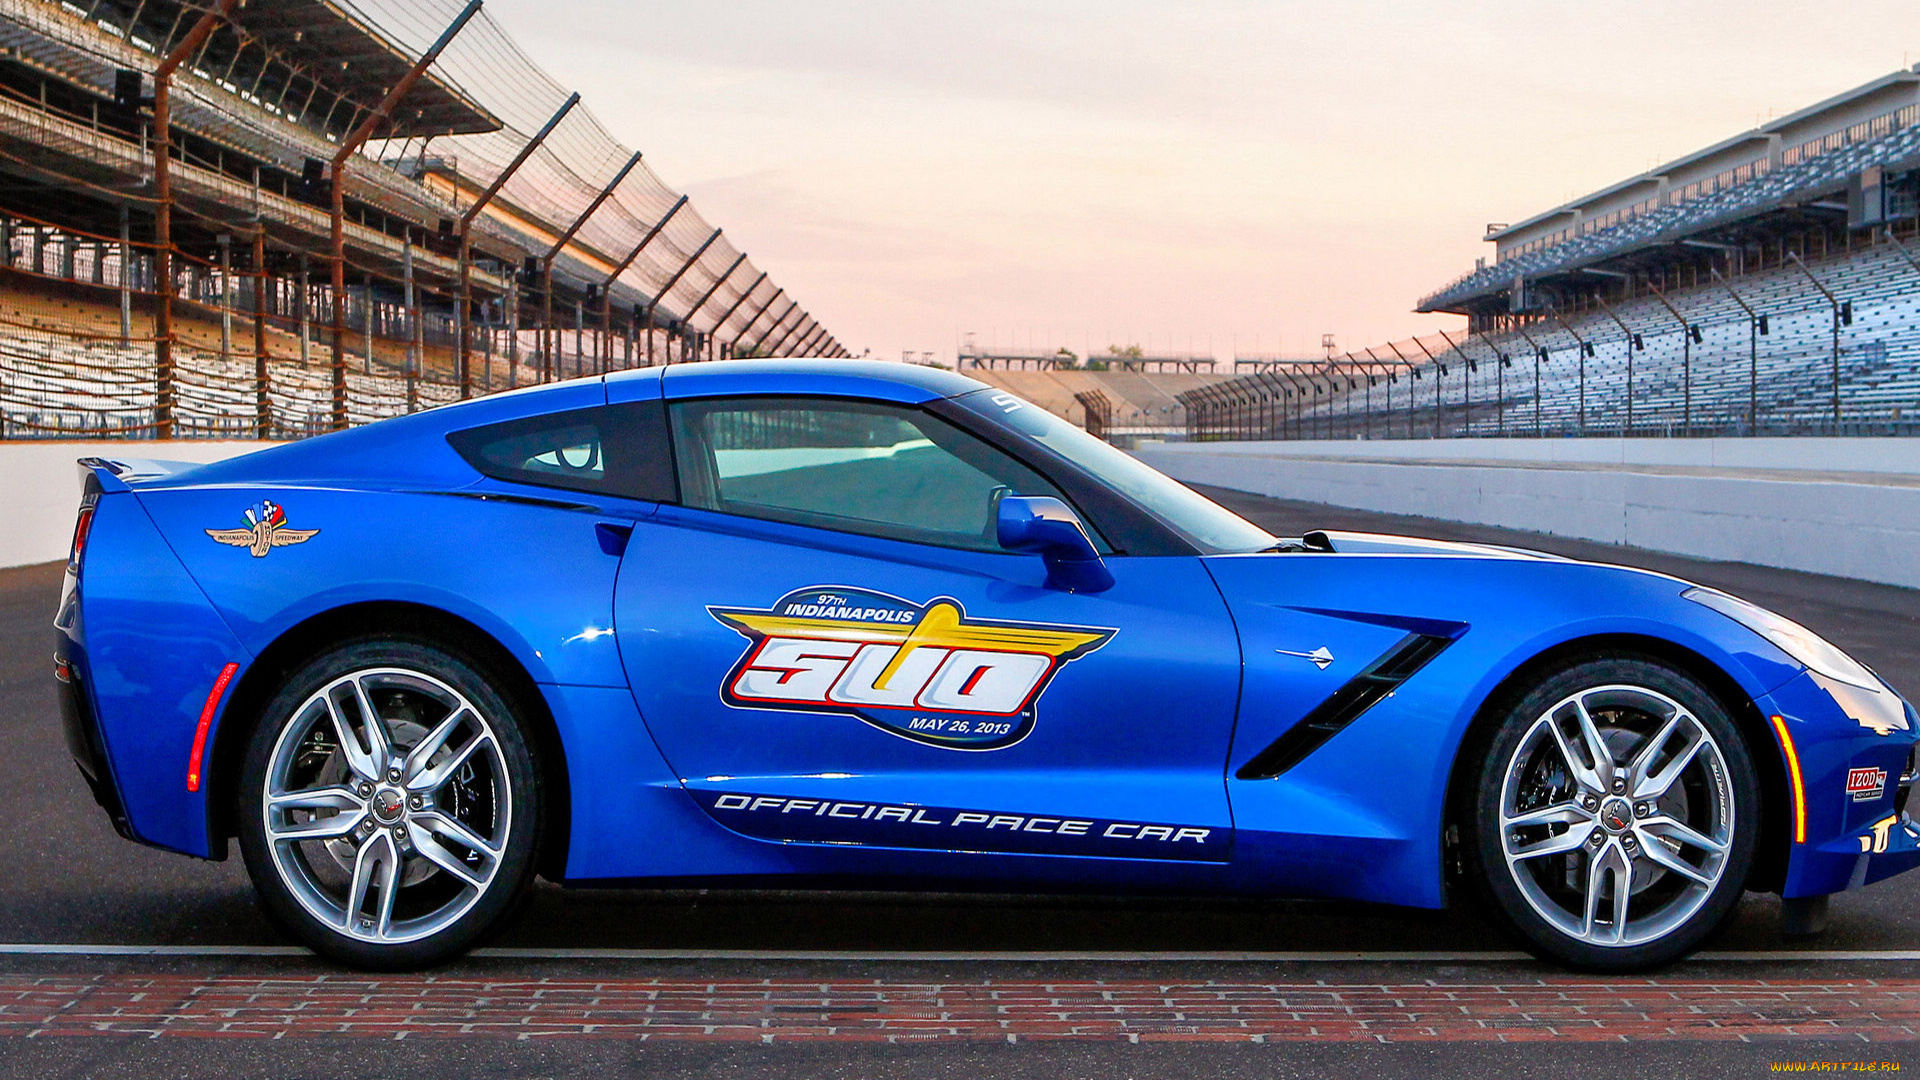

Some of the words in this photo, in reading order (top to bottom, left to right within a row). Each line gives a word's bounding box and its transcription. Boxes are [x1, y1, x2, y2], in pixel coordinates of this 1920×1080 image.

[816, 594, 848, 606] 97TH
[783, 603, 916, 623] INDIANAPOLIS
[733, 637, 1051, 714] 500
[908, 717, 949, 729] MAY
[948, 721, 971, 733] 26,
[974, 722, 1011, 735] 2013
[1850, 771, 1876, 788] IZOD
[714, 794, 942, 825] OFFICIAL
[951, 812, 1094, 835] PACE
[1103, 823, 1211, 843] CAR
